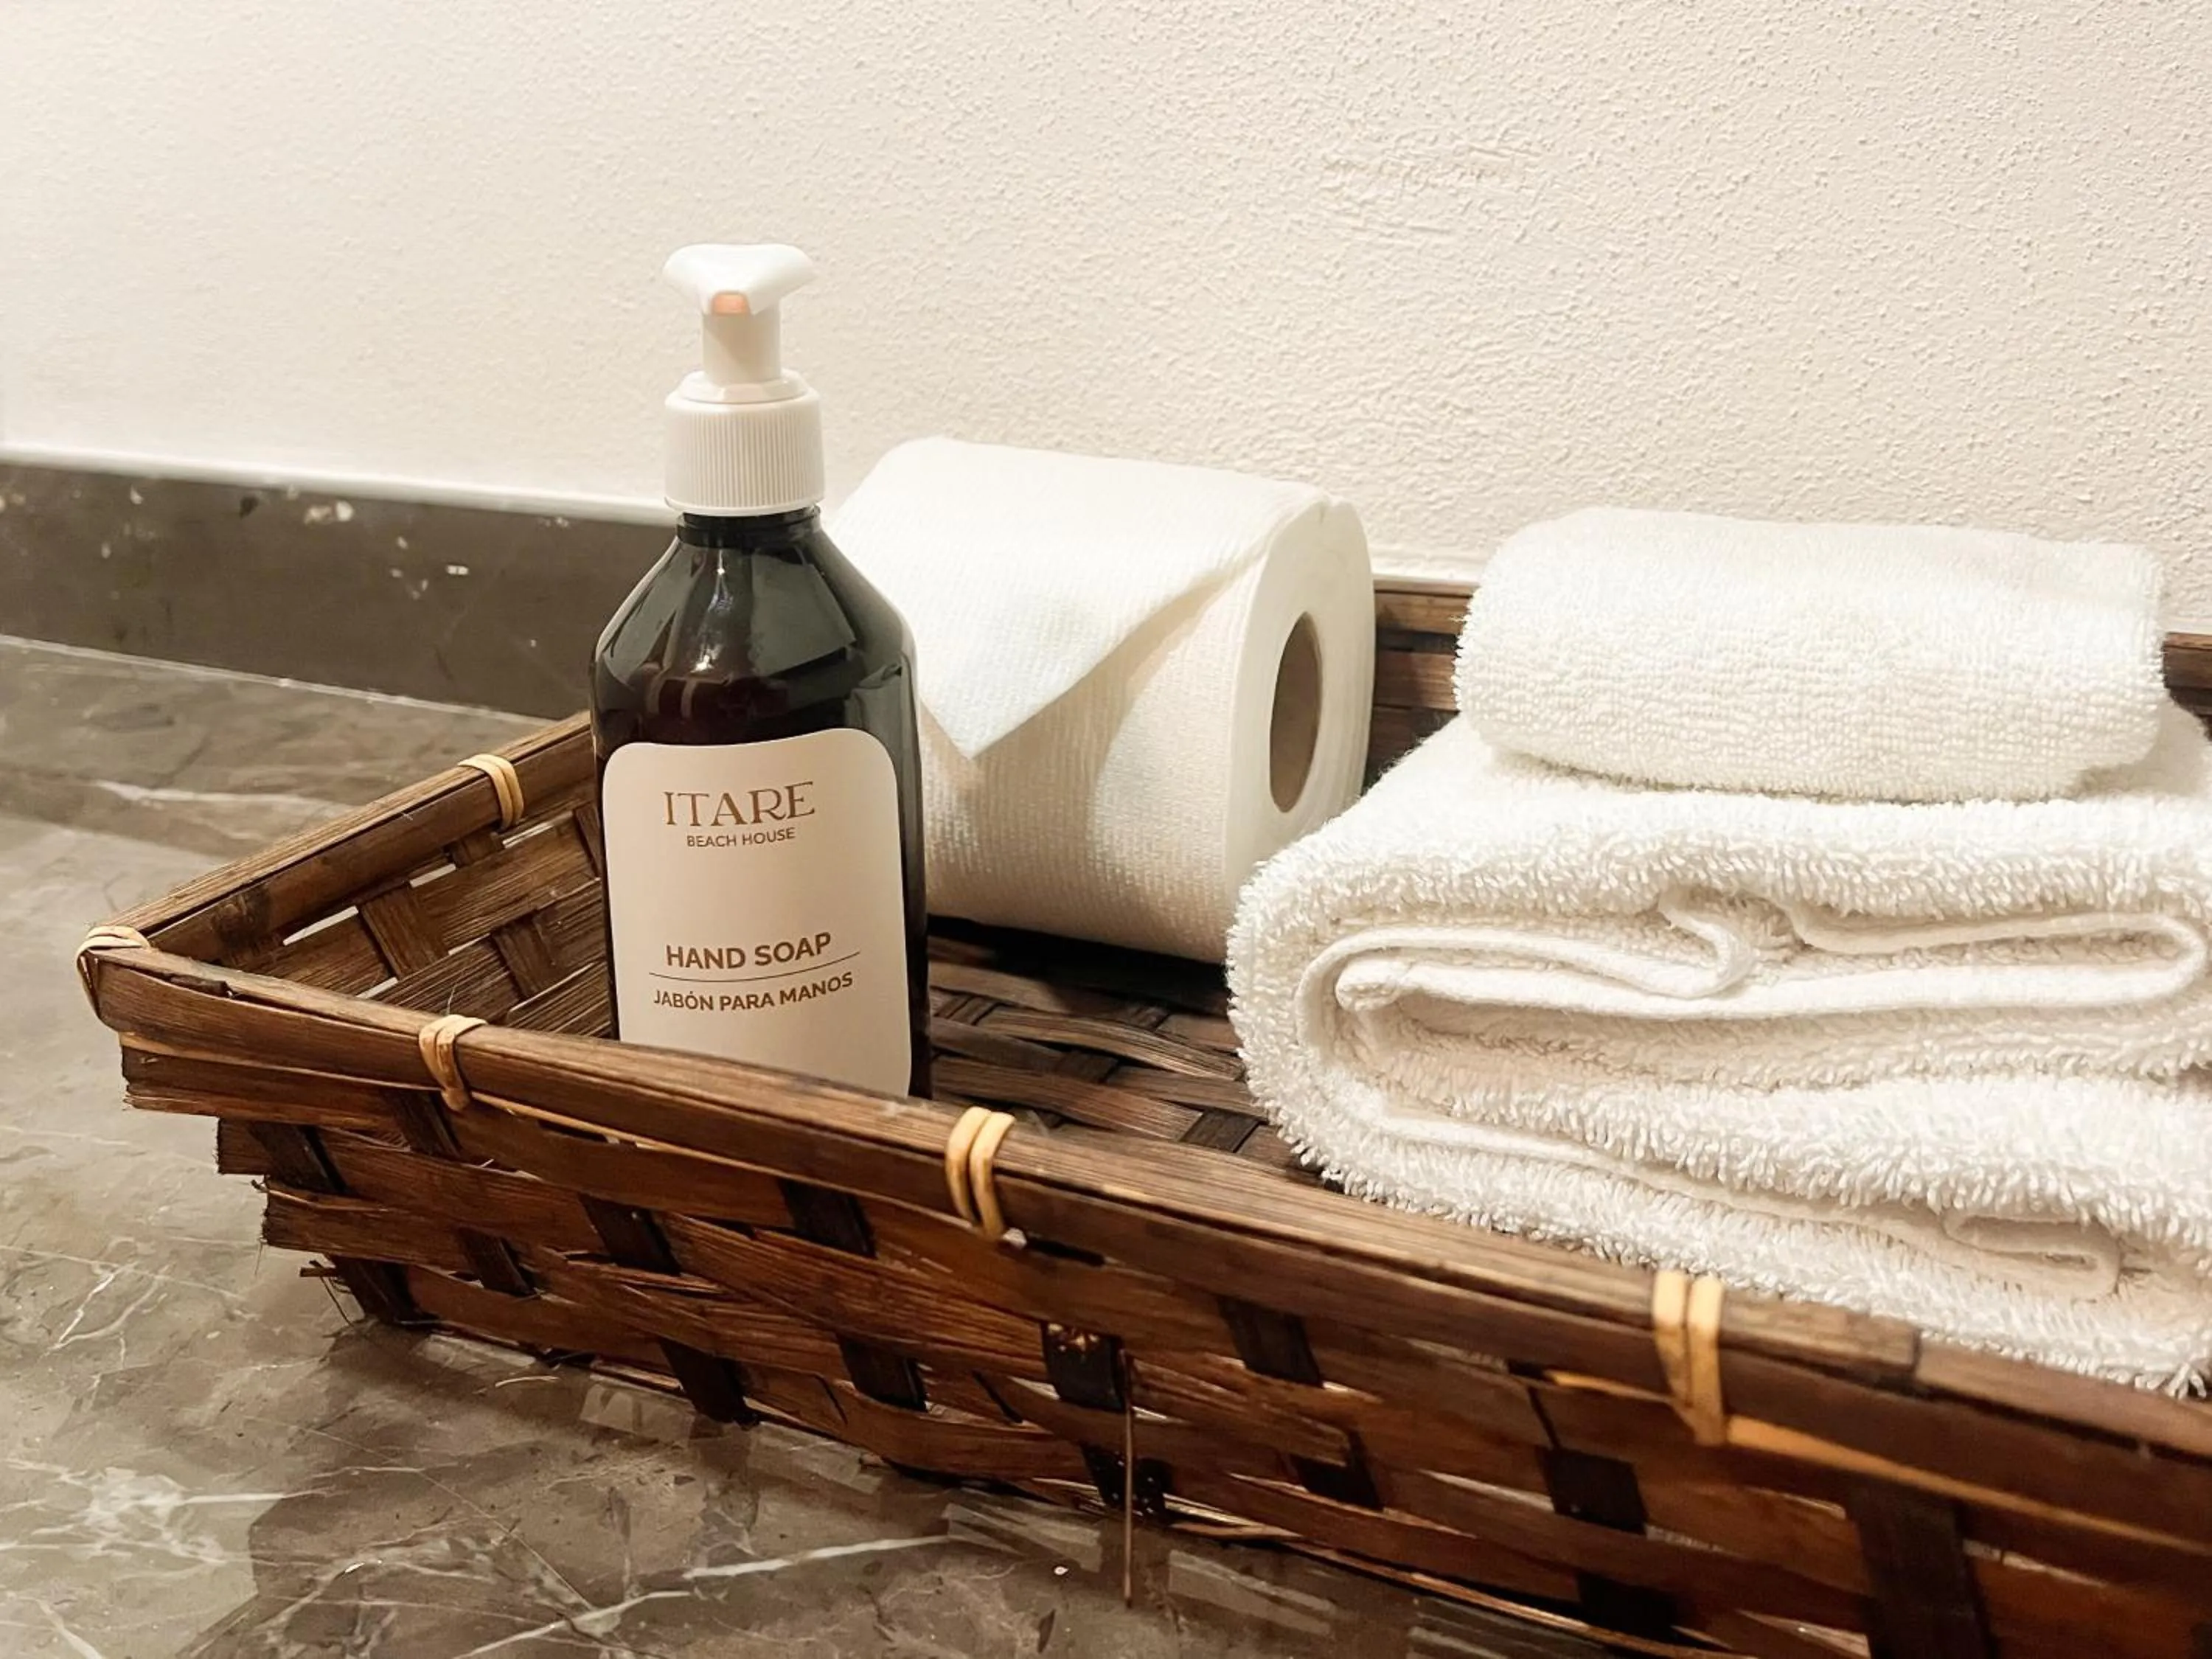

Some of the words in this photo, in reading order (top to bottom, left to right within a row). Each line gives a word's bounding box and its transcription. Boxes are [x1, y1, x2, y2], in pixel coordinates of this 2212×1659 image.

[664, 781, 815, 827] ITARE
[686, 835, 737, 847] BEACH
[742, 827, 796, 846] HOUSE
[666, 945, 746, 970] HAND
[754, 931, 831, 967] SOAP
[653, 990, 714, 1011] JABÓN
[719, 992, 775, 1012] PARA
[779, 971, 853, 1005] MANOS
